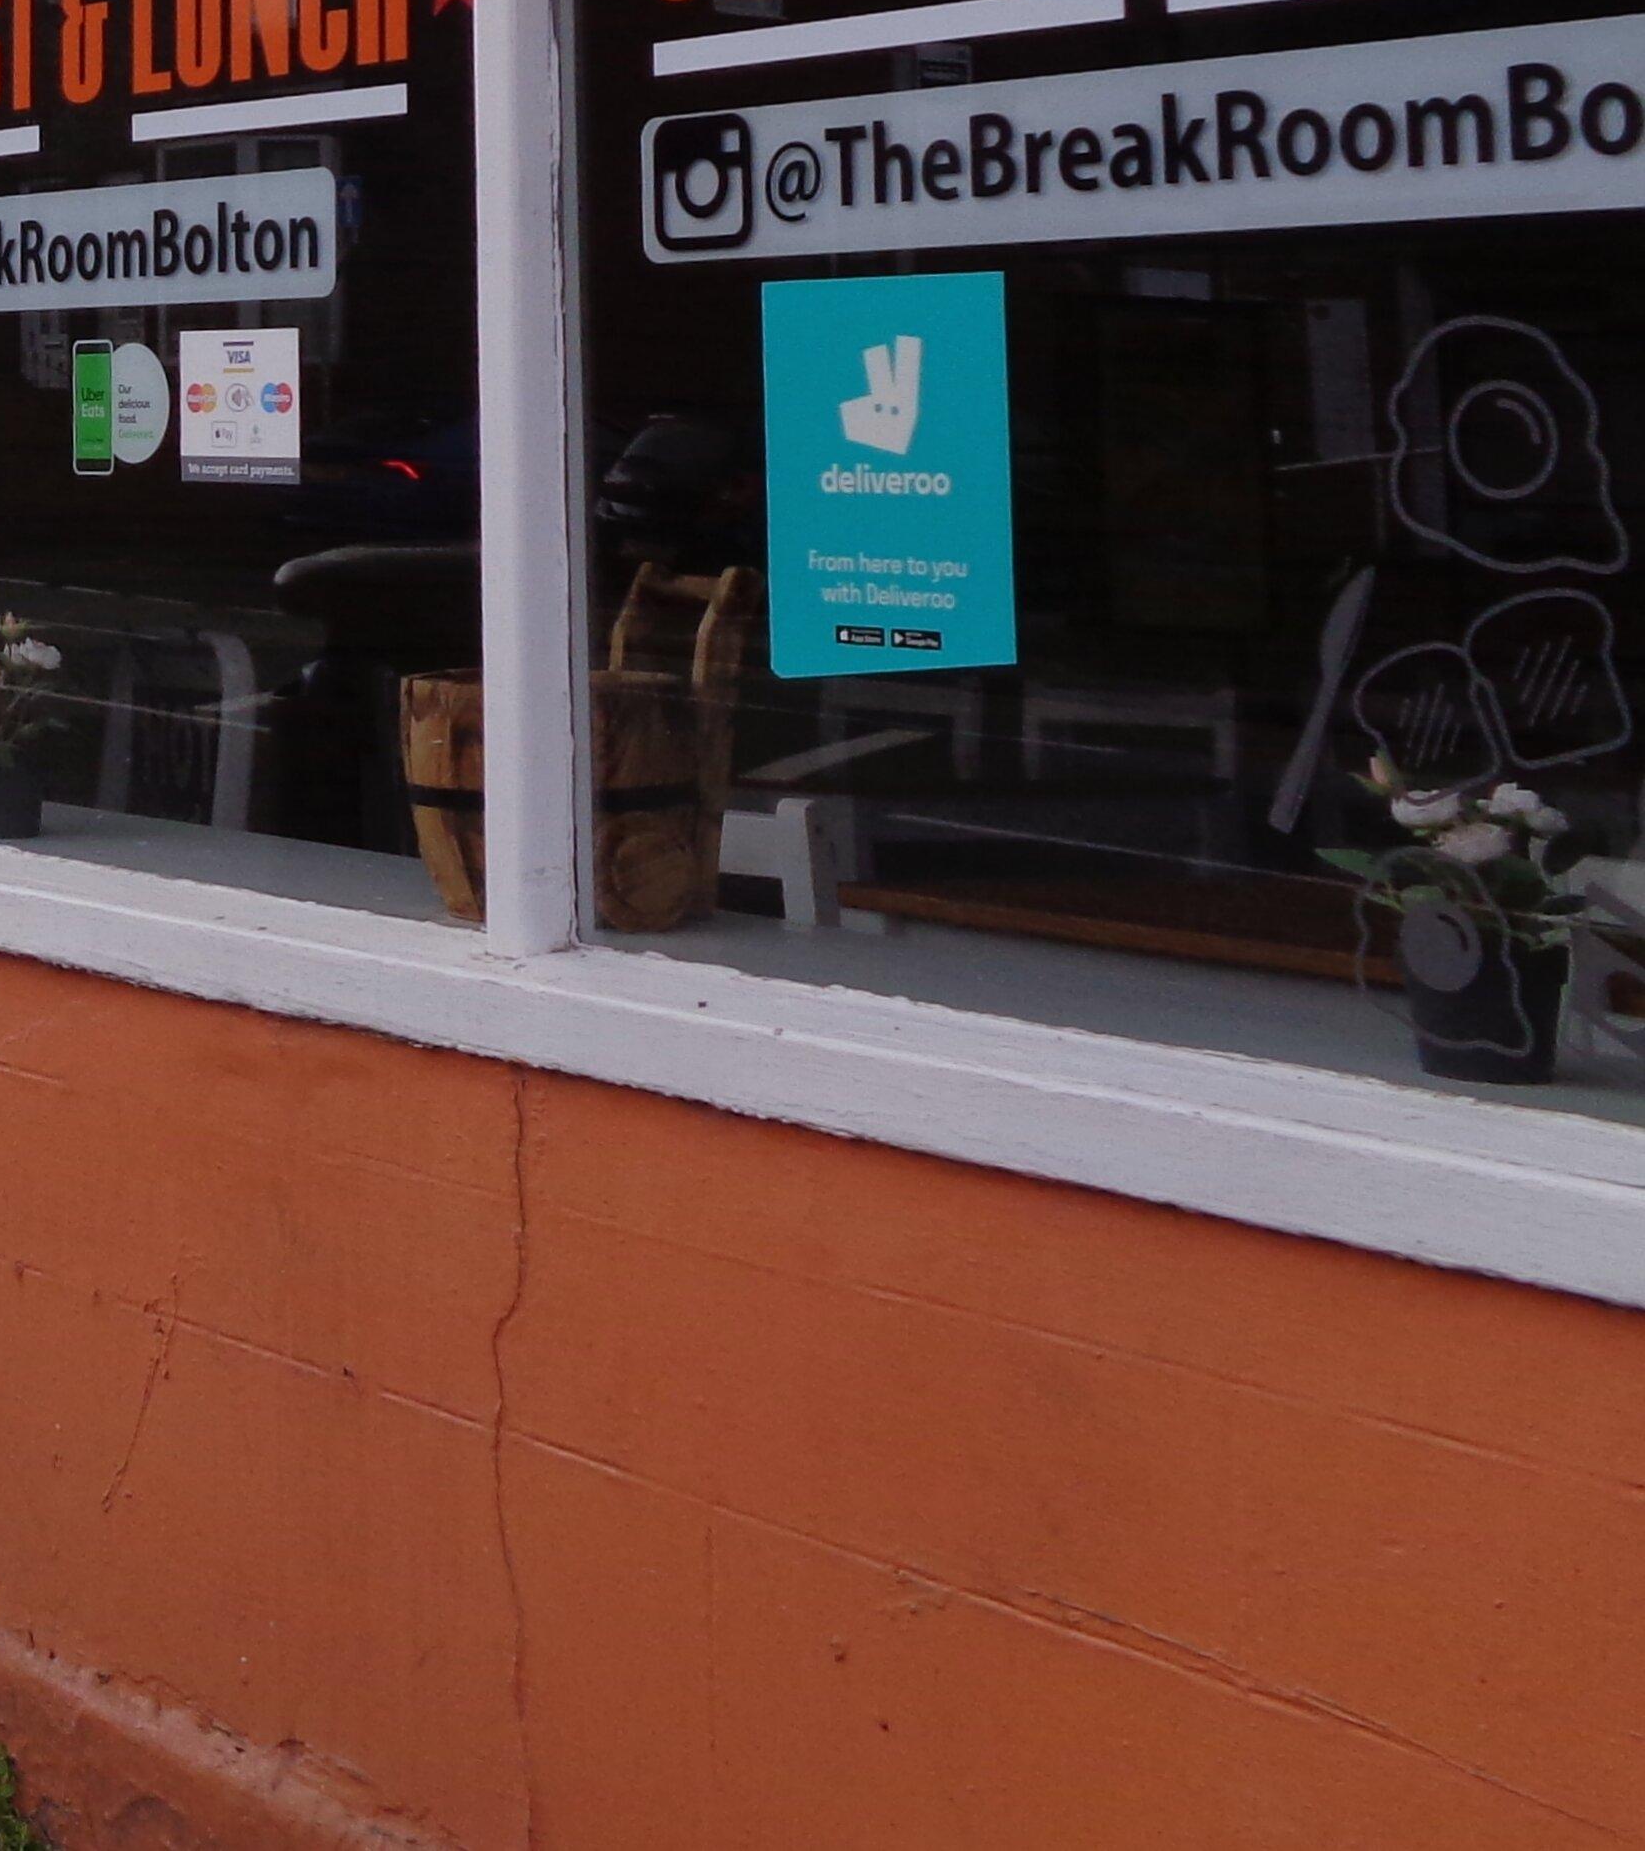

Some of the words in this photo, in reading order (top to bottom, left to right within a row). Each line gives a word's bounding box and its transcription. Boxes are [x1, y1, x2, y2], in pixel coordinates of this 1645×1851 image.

[226, 350, 252, 365] VISA
[81, 387, 105, 401] Uber
[81, 403, 105, 418] Eats
[188, 463, 200, 474] We
[201, 464, 229, 477] accept
[230, 464, 249, 475] card
[820, 463, 951, 495] deliveroo
[808, 549, 854, 572] From
[858, 552, 903, 575] here
[907, 556, 927, 576] to
[931, 559, 969, 584] you
[820, 582, 861, 605] with
[865, 582, 956, 610] Deliveroo
